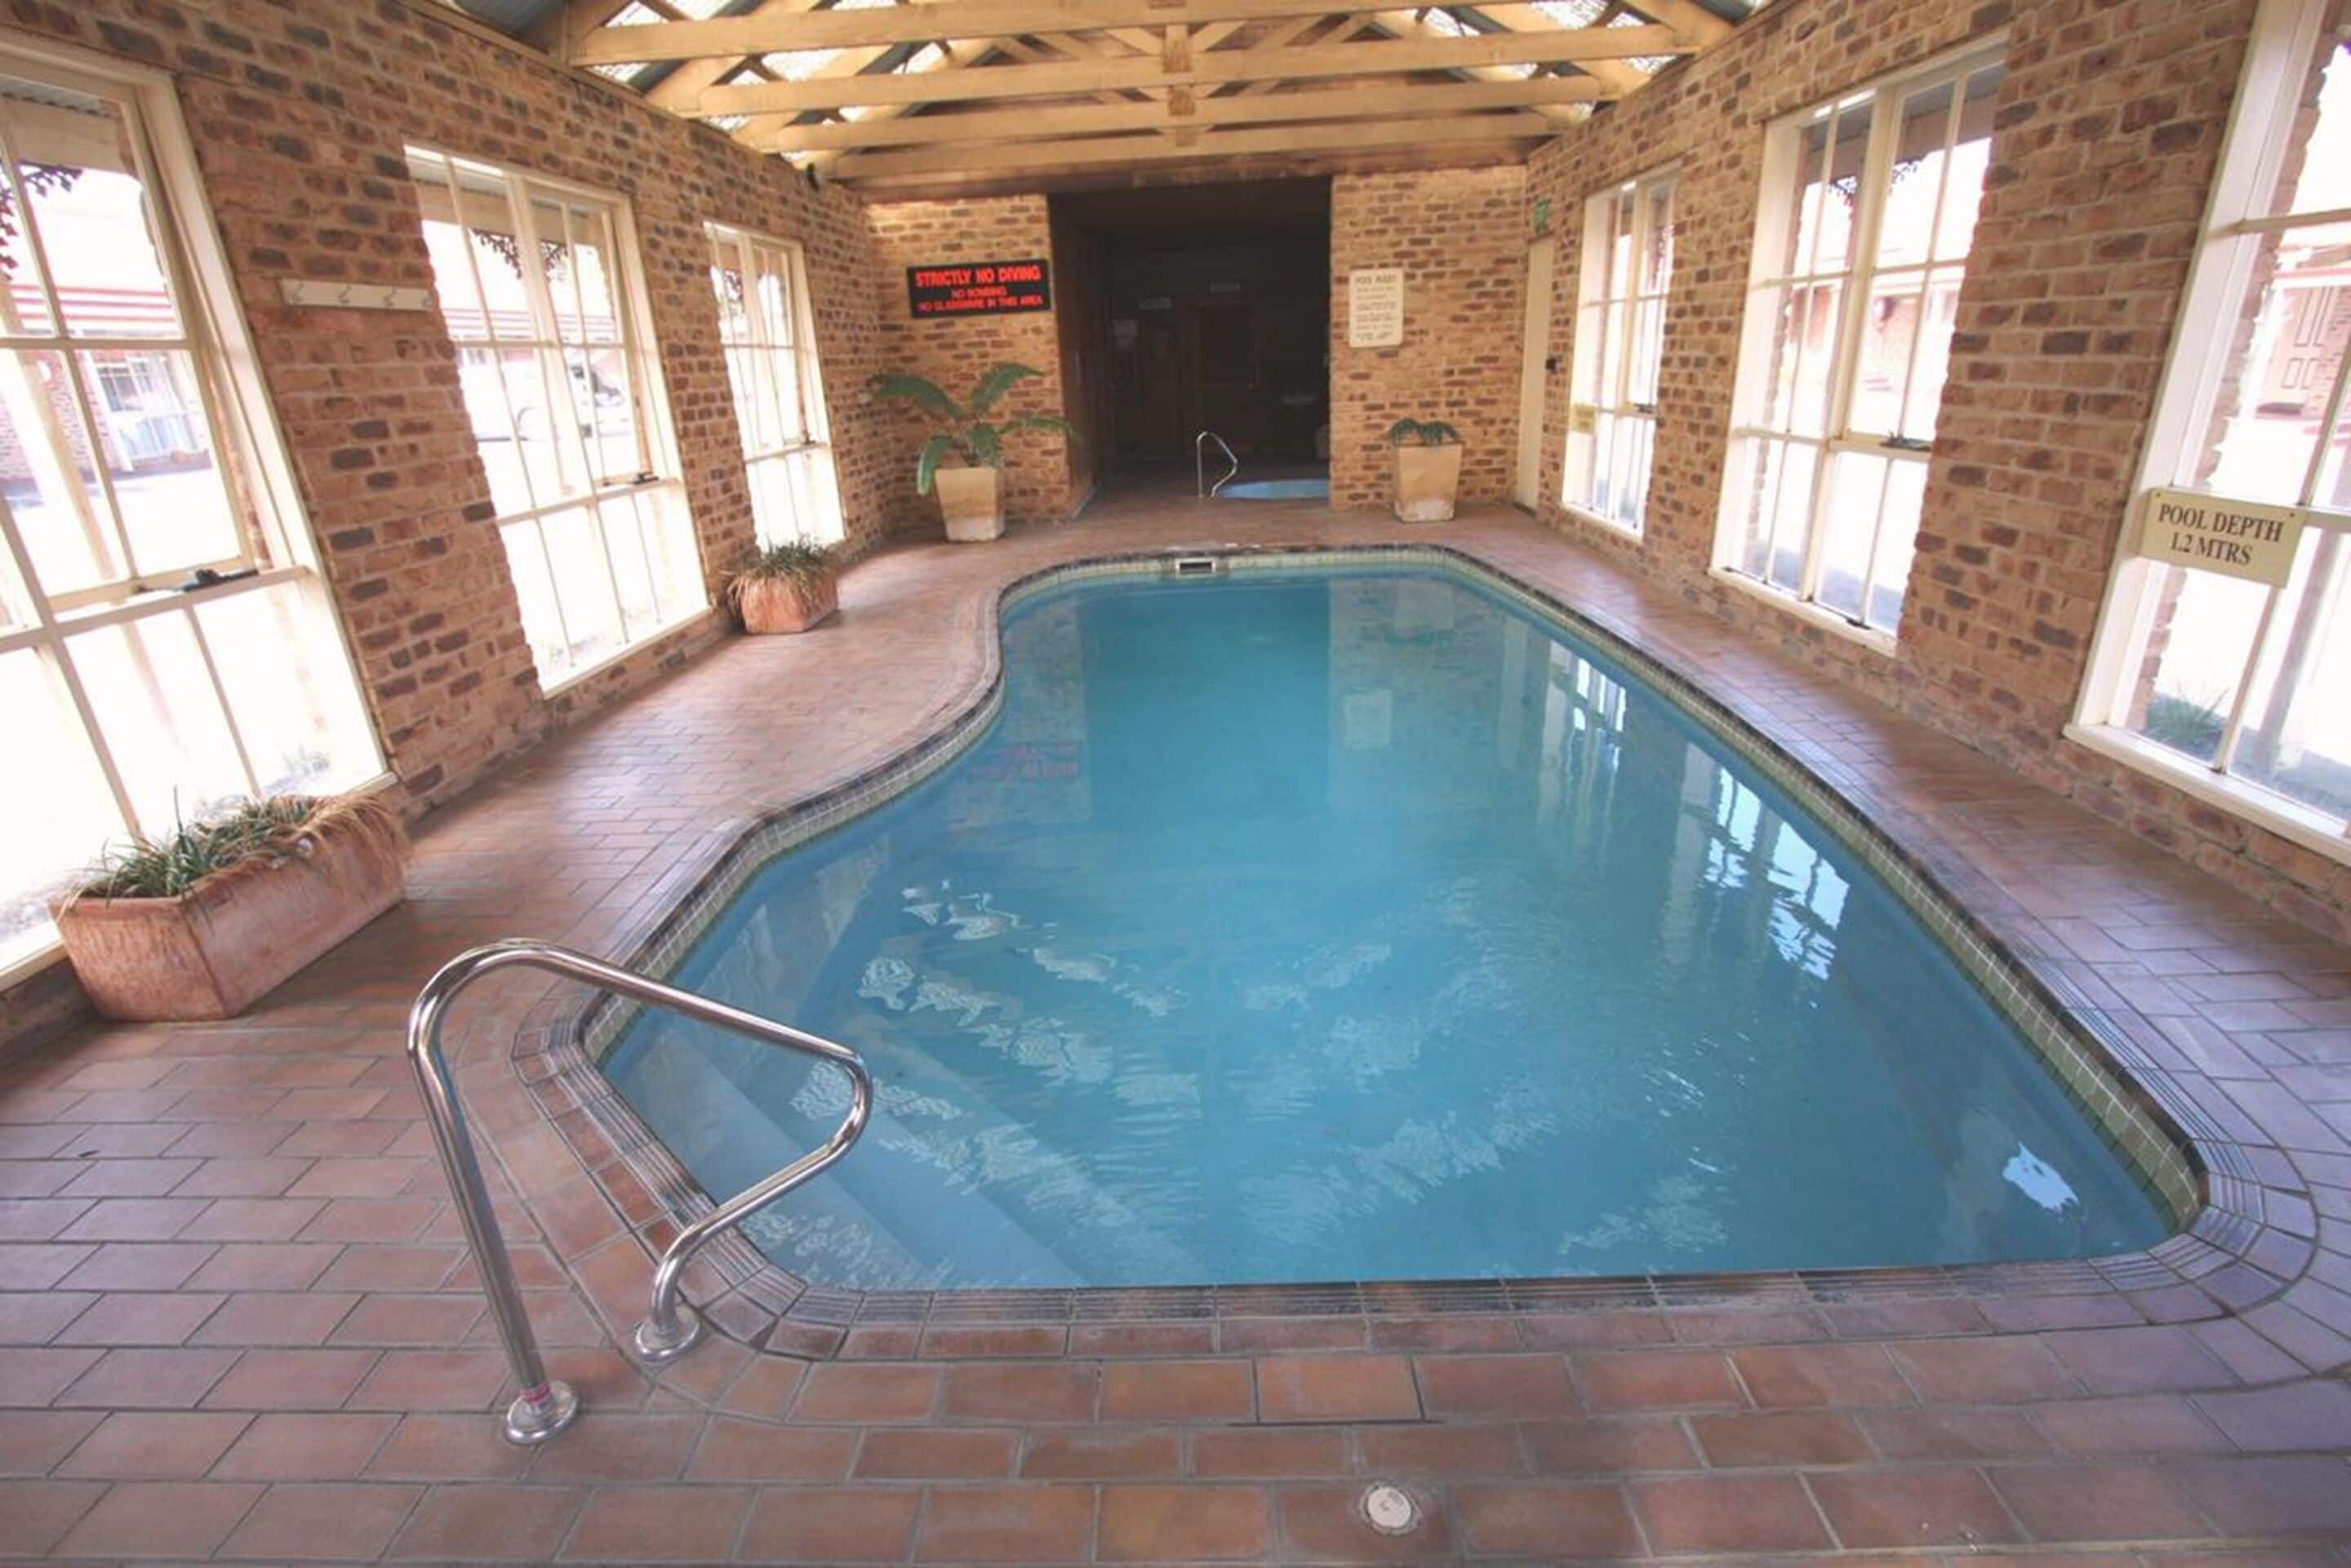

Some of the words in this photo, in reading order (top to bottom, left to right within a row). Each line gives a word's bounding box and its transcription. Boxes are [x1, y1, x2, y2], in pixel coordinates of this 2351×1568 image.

[915, 269, 971, 287] STRICTLY
[976, 268, 994, 283] NO
[998, 264, 1041, 282] DIVING
[951, 289, 966, 298] NO
[2158, 503, 2207, 530] POOL
[2211, 512, 2285, 543] DEPTH
[2171, 532, 2193, 553] 1.2
[2196, 536, 2253, 565] MTRS
